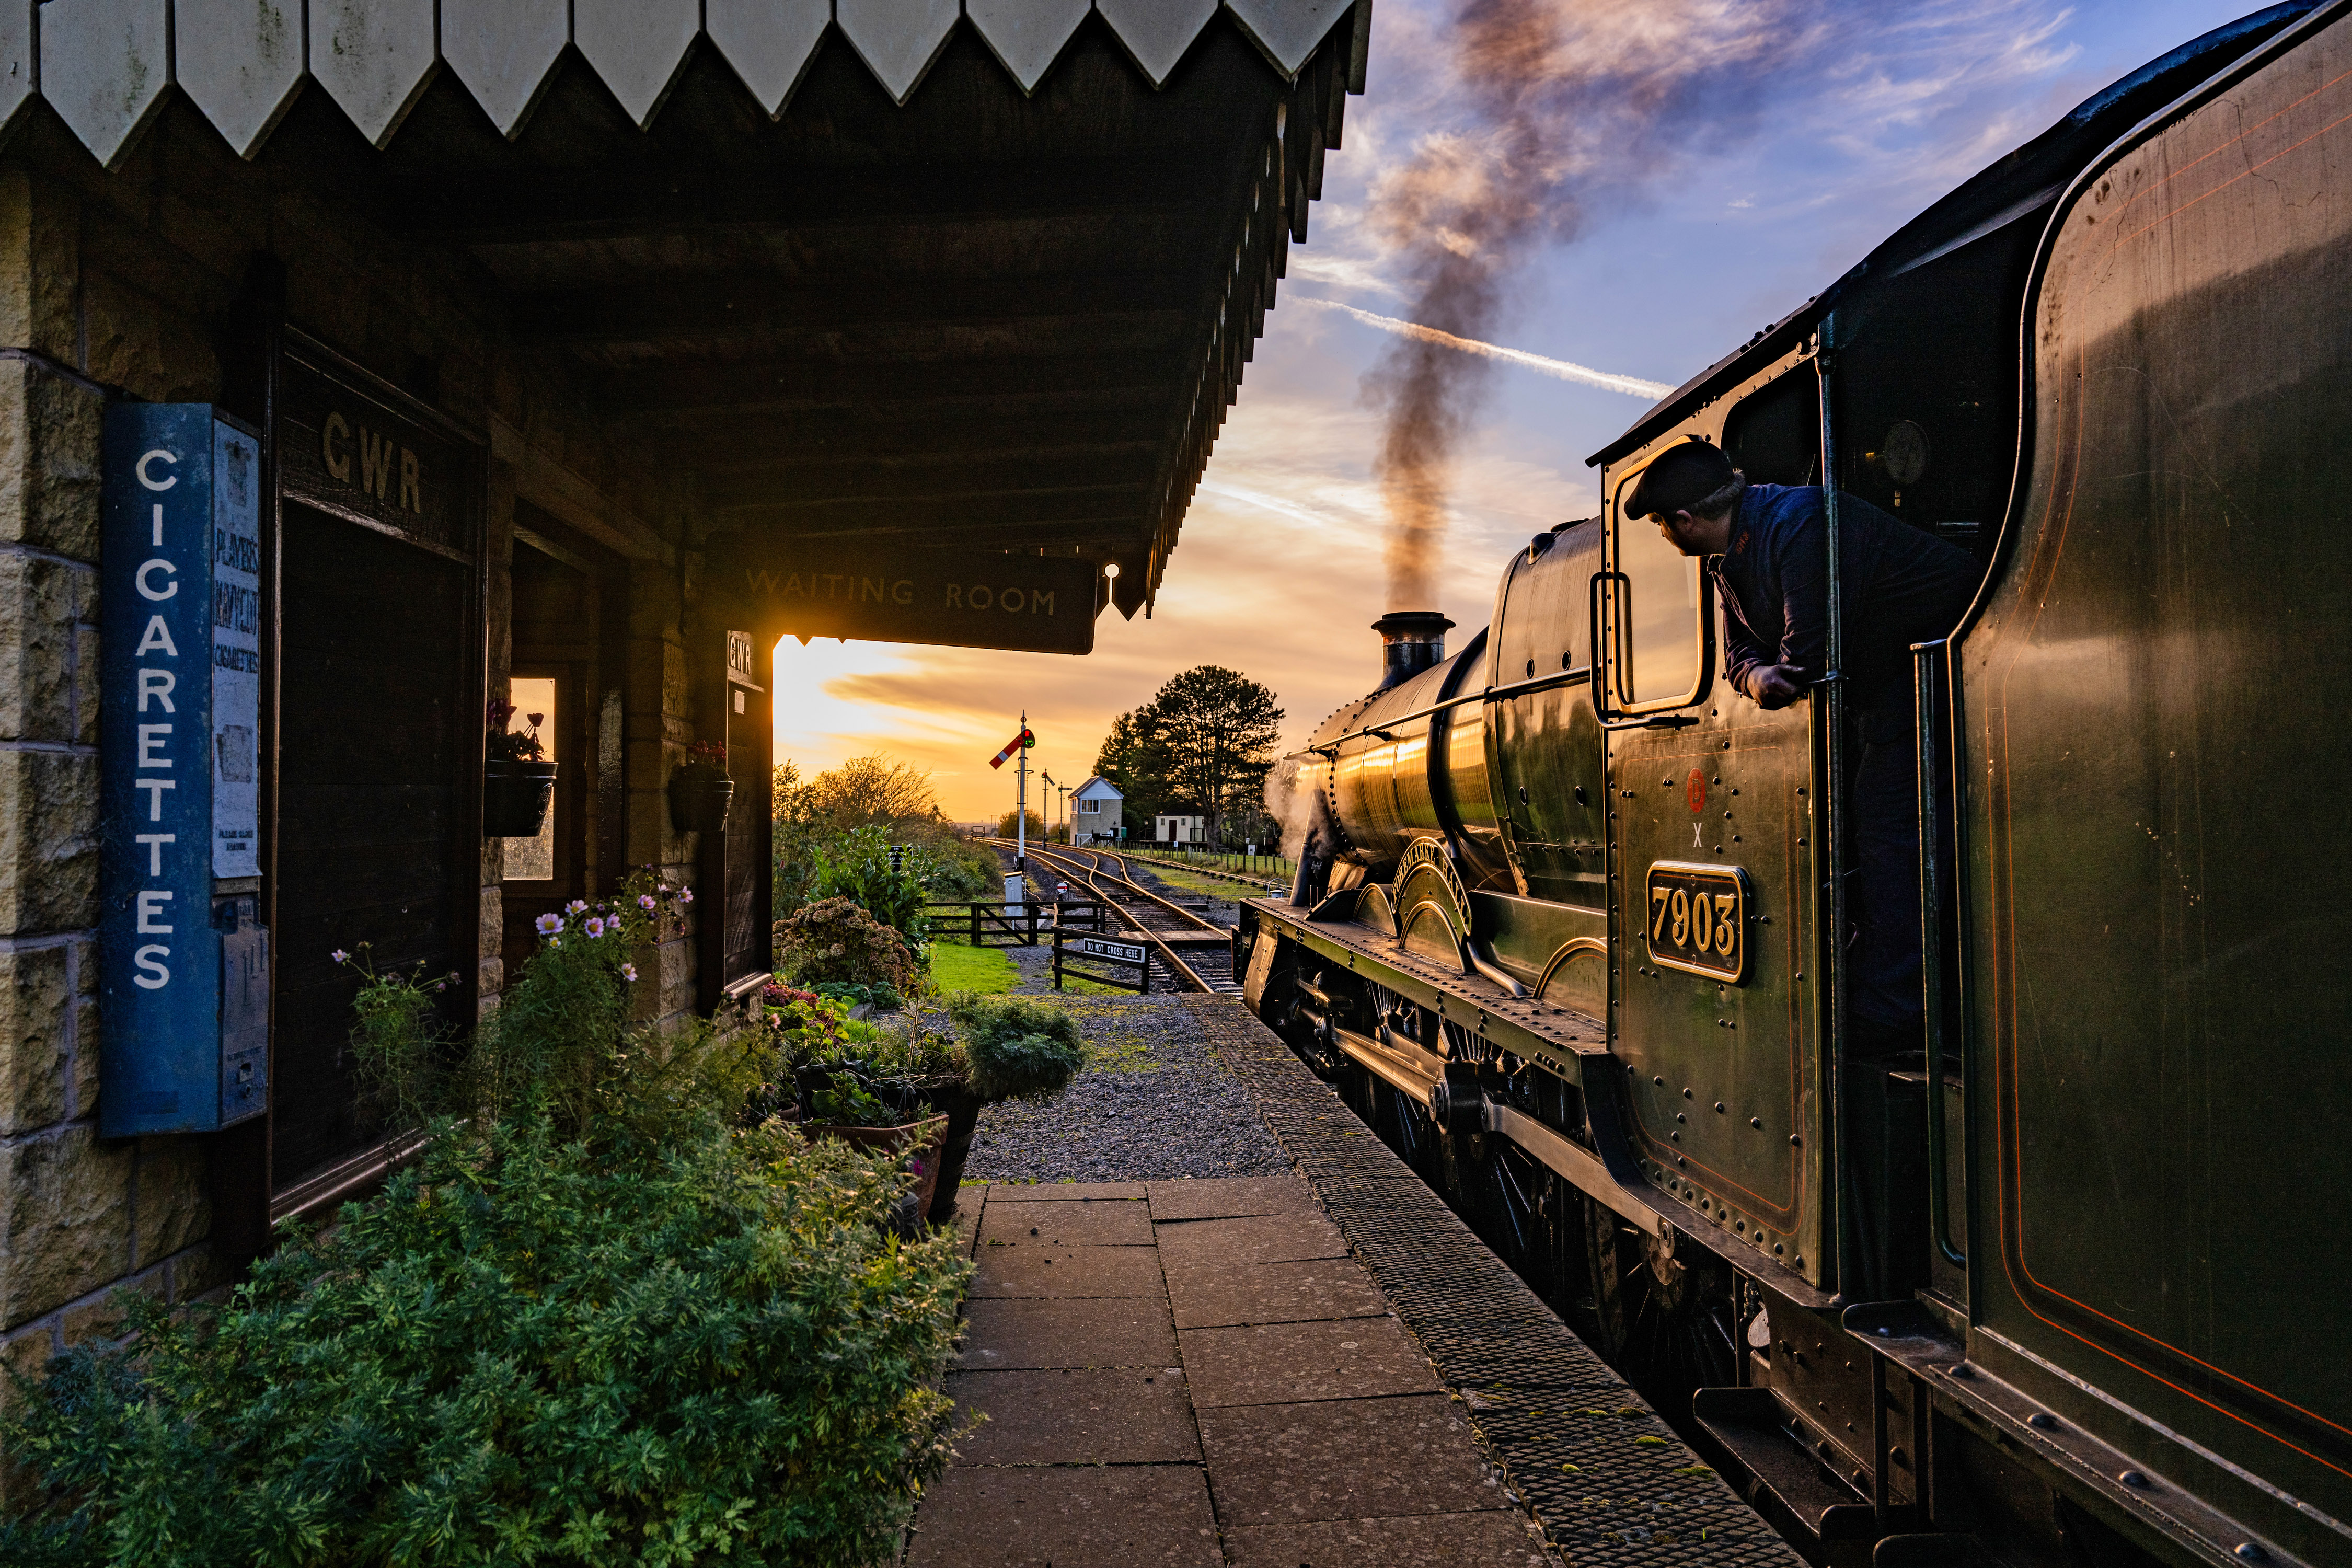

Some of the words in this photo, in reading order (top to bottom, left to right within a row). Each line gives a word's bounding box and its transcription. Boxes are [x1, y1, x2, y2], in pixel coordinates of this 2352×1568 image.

[325, 411, 421, 514] GWR
[745, 568, 914, 606] WAITING
[946, 582, 1055, 616] ROOM
[730, 637, 751, 675] GWR
[133, 449, 178, 991] CIGARETTES
[1693, 822, 1702, 848] X
[1392, 842, 1437, 903] FOREMARKE
[1442, 857, 1469, 924] HALL
[1088, 942, 1093, 951] DO
[1095, 943, 1103, 952] NOT
[1107, 945, 1123, 956] CROSS
[1125, 948, 1138, 959] HERE
[1652, 886, 1737, 956] 7903
